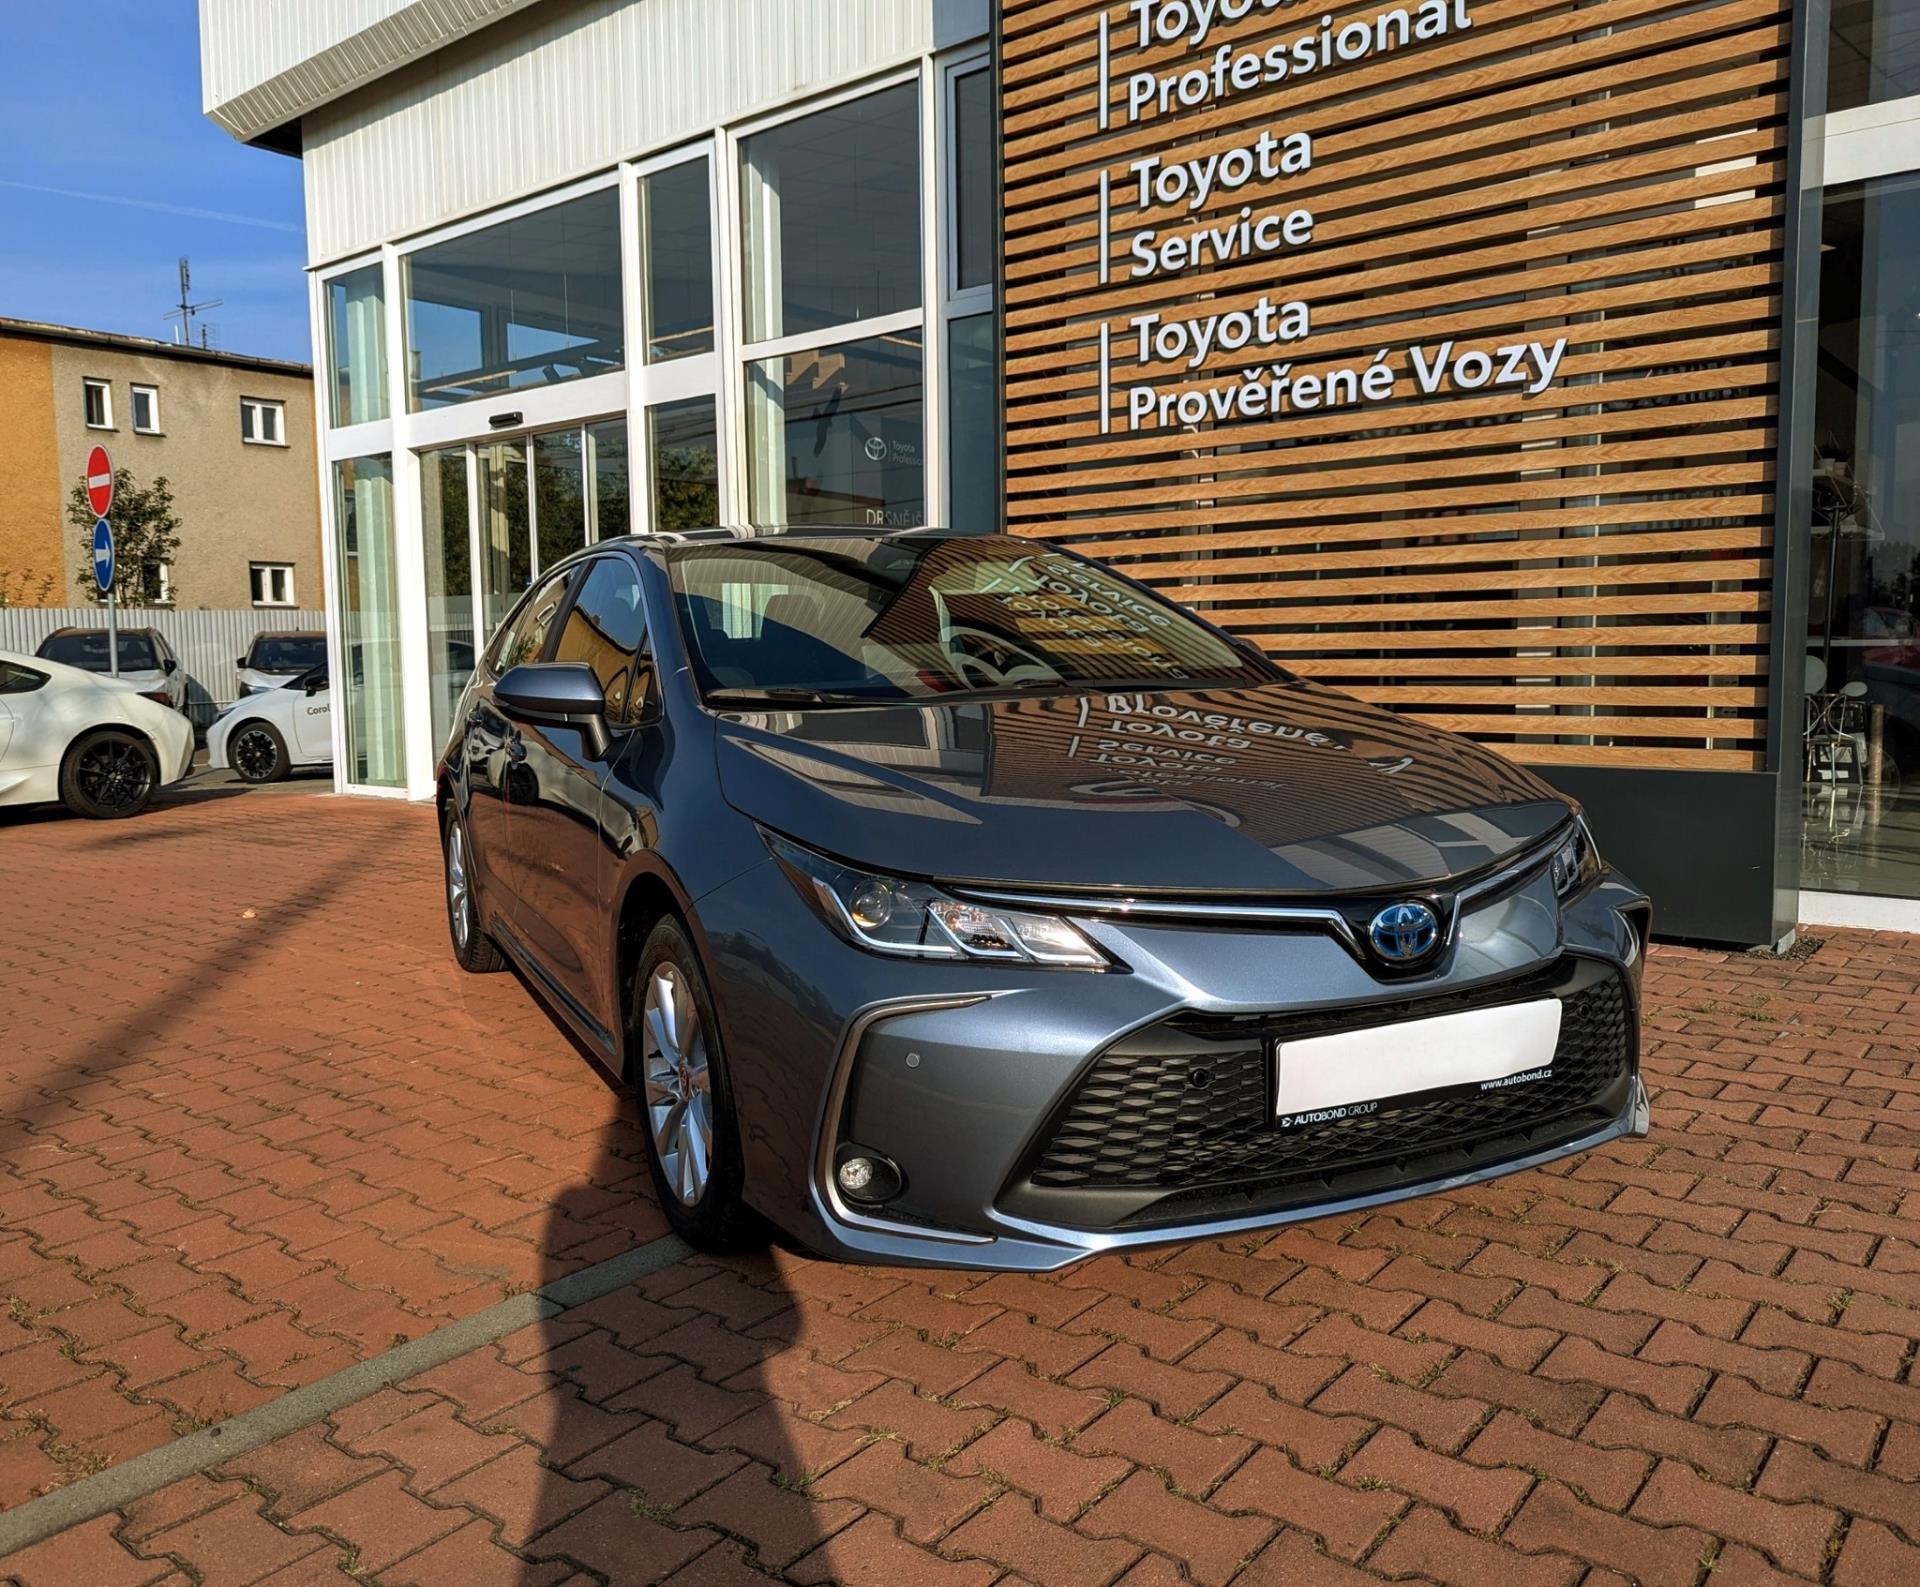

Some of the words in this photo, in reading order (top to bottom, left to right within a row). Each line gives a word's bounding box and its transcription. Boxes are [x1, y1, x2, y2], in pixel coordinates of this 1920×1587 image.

[1130, 0, 1292, 47] Toyo
[1129, 0, 1472, 121] Professional
[1130, 130, 1312, 209] Toyota
[1130, 207, 1313, 278] Service
[1130, 297, 1310, 367] Toyota
[1129, 349, 1394, 431] Prověřené
[1410, 338, 1568, 395] Vozy
[892, 440, 915, 453] Toyota
[1293, 1107, 1347, 1126] AUTOBOND
[1347, 1102, 1378, 1116] GROUP
[1480, 1069, 1553, 1091] www.autobond.cz
